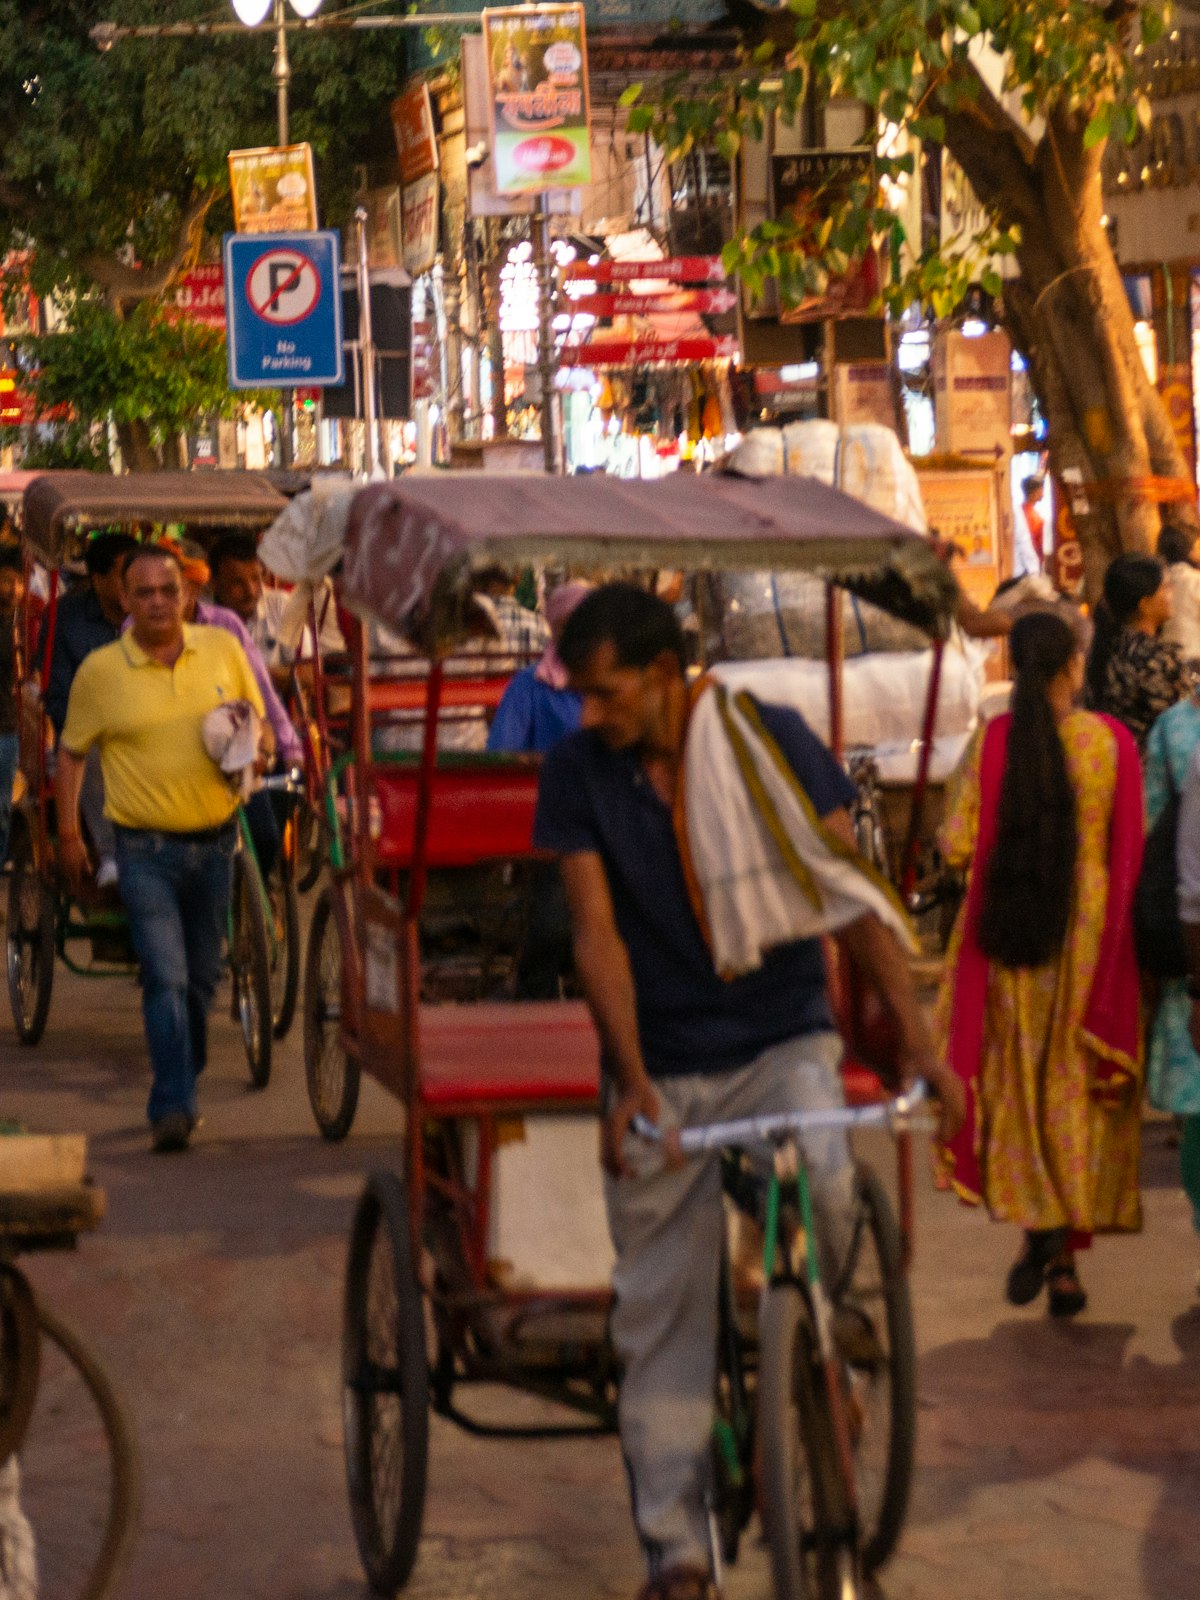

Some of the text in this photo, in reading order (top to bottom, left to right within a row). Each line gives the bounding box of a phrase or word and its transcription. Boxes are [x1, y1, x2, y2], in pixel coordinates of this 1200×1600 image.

[269, 261, 301, 312] P
[276, 339, 296, 354] No
[261, 355, 313, 371] Parking
